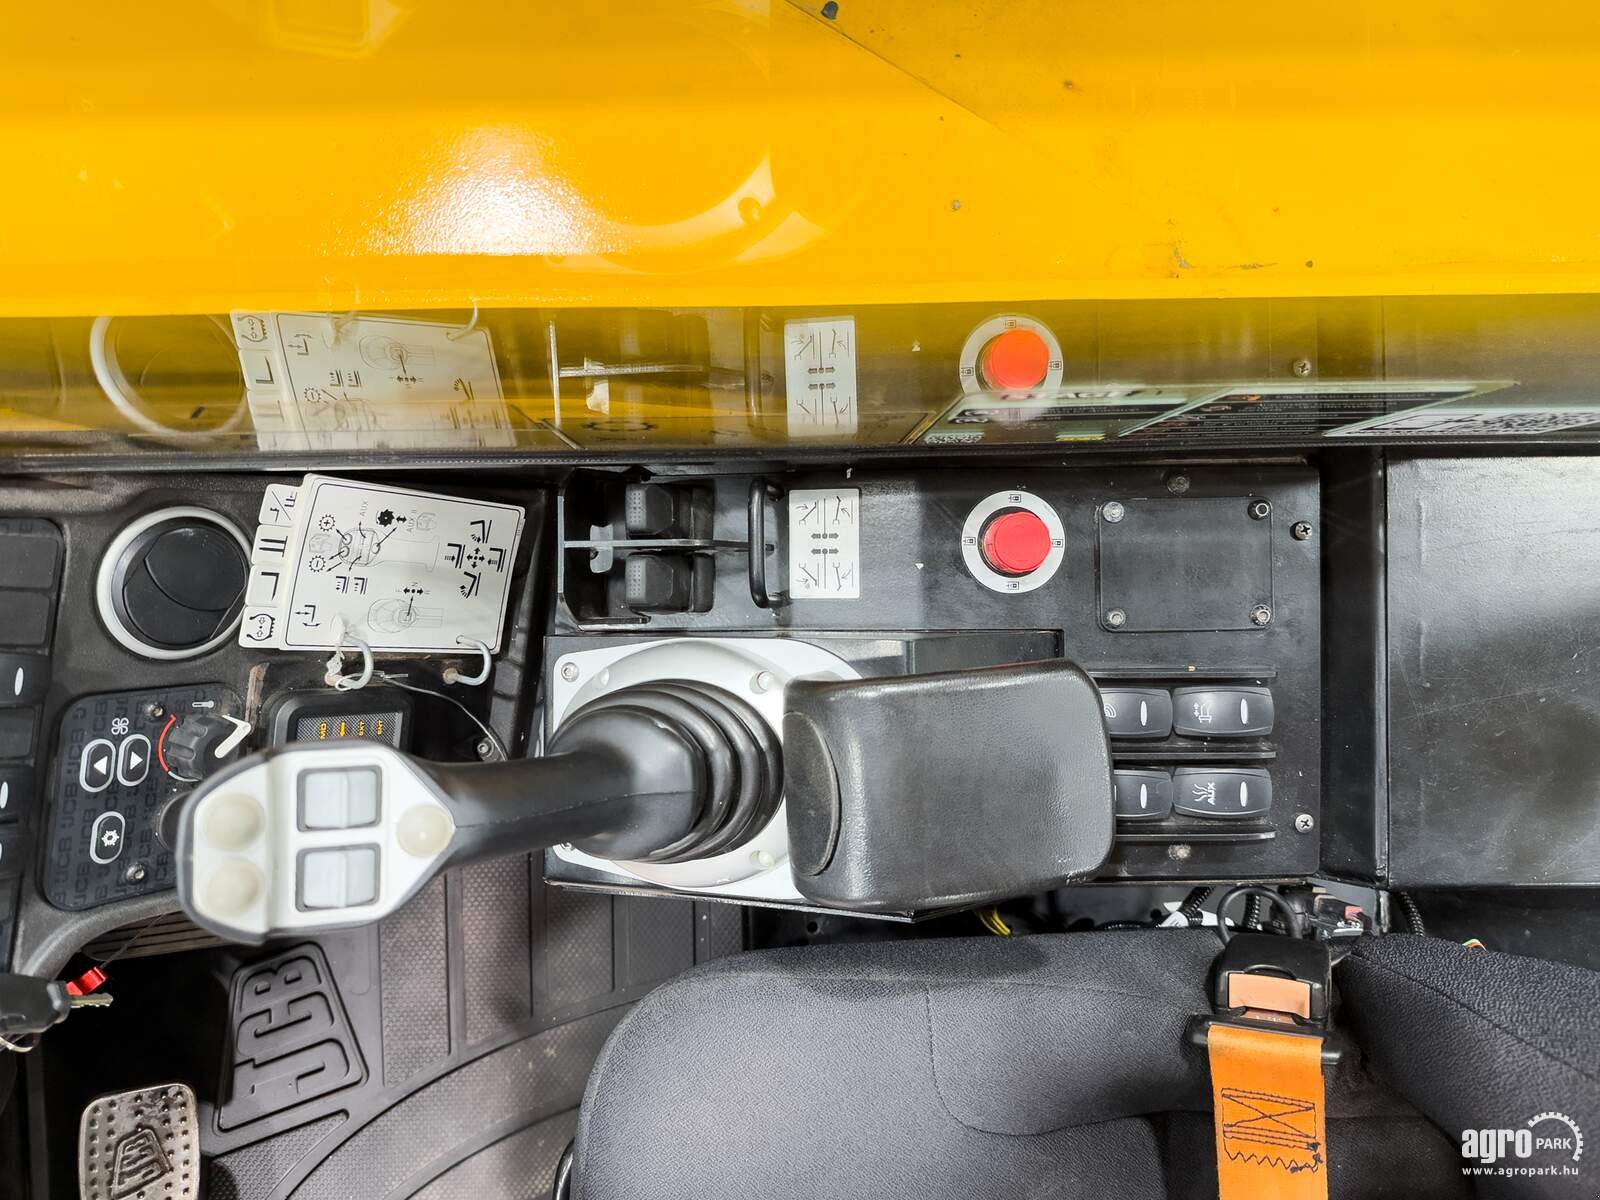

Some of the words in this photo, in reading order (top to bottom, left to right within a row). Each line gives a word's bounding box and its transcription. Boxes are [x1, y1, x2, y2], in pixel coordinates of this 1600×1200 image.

[60, 783, 78, 829] JCB
[1207, 782, 1216, 805] AUX
[53, 836, 73, 885] JCB
[232, 953, 351, 1096] JCB
